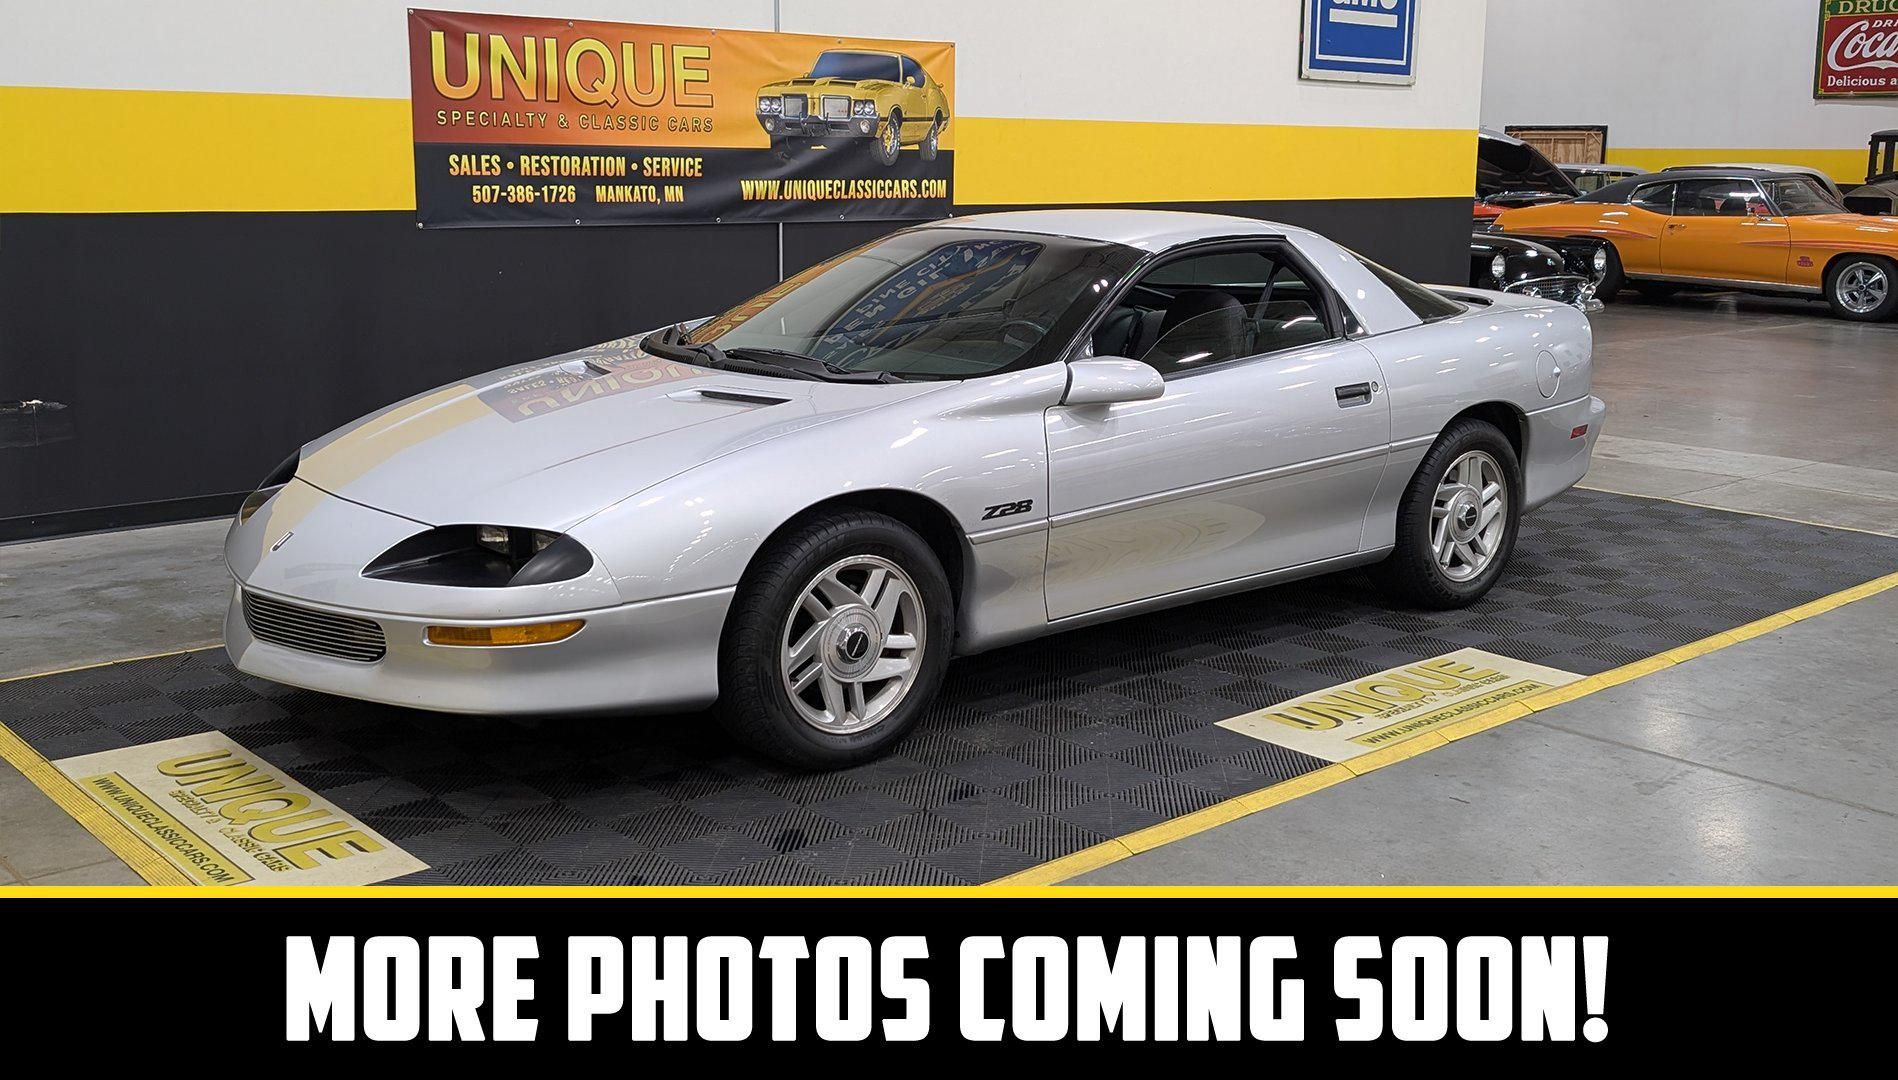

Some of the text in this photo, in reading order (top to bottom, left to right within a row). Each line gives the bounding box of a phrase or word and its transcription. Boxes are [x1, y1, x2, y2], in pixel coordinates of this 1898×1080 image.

[430, 30, 714, 107] UNIQUE
[1827, 75, 1886, 86] Delicious
[436, 110, 713, 132] SPECIALTY & CLASSIC CARS
[449, 154, 703, 177] SALES RESTORATION SERVICE
[472, 185, 684, 205] 507-386-1726 MANKATO, MN
[740, 179, 947, 201] WWW.UNIQUECLASSICCARS.COM
[981, 499, 1033, 520] Z28
[1266, 658, 1500, 730] UNIQUE
[157, 749, 386, 870] UNIQUE
[92, 777, 235, 883] WWW.UNIQUECLASSICCARS.COM
